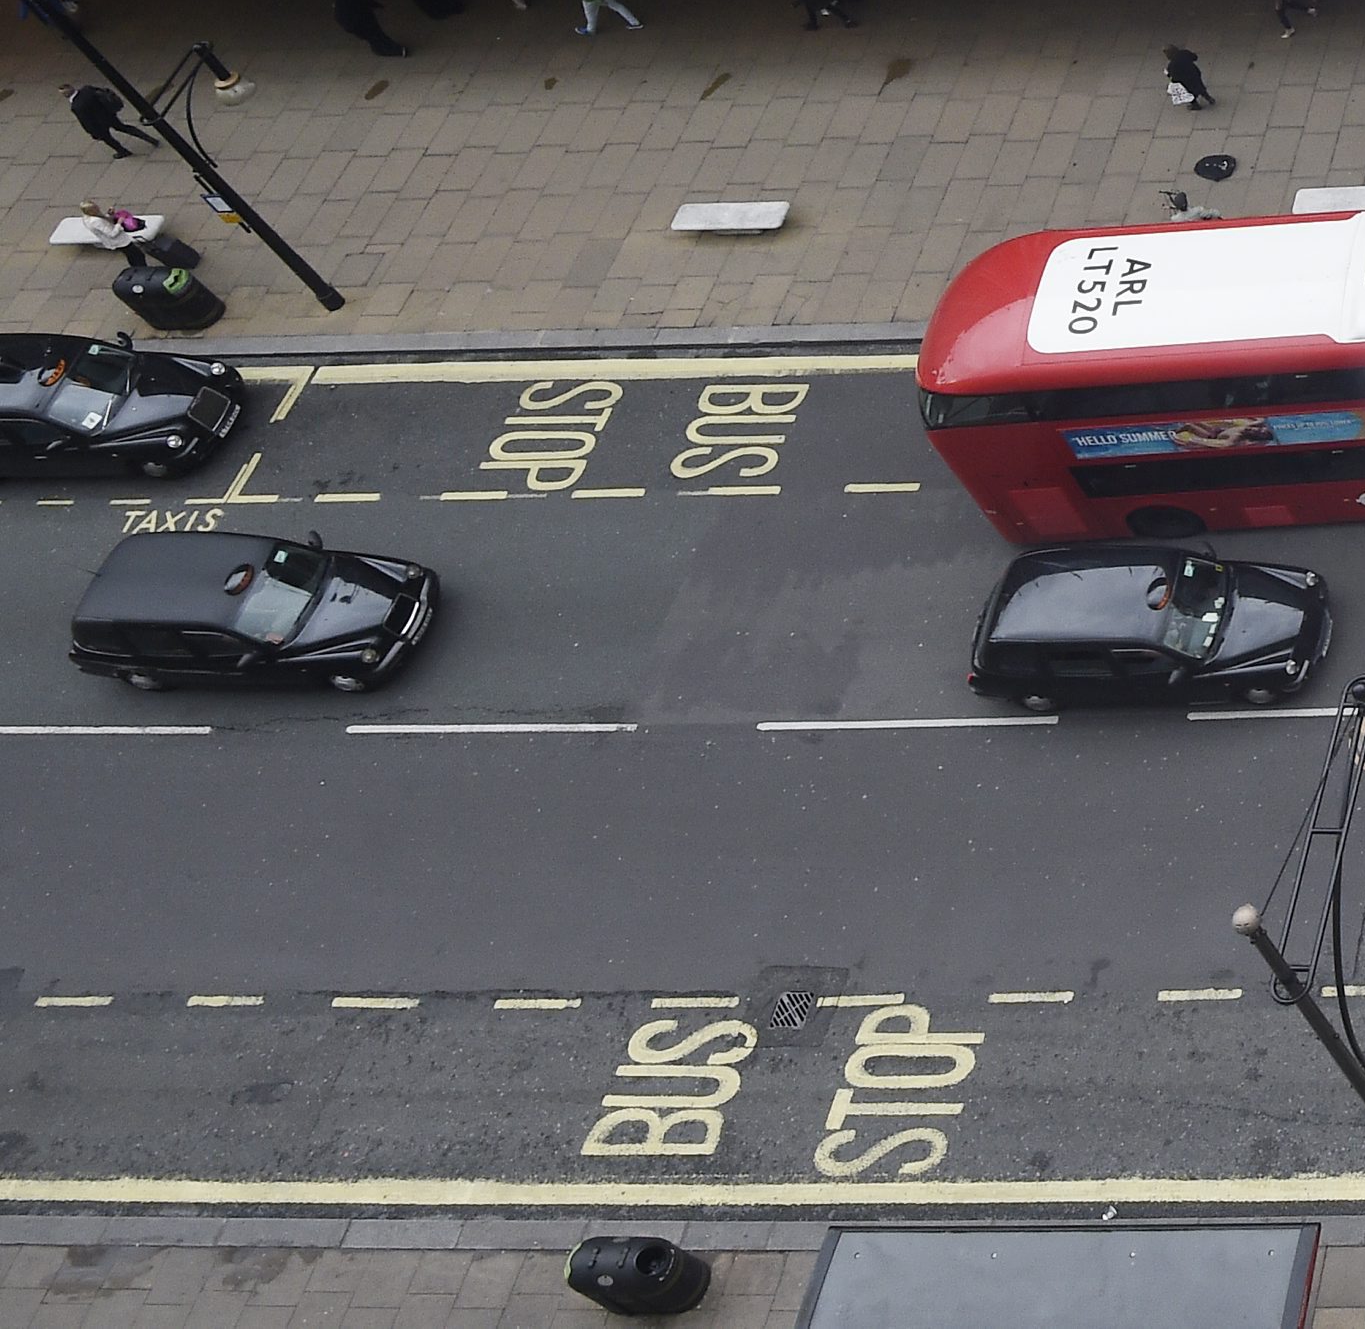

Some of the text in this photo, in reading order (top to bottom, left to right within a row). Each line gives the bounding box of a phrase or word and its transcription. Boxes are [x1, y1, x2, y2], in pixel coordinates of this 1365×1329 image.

[1068, 246, 1119, 334] LT520
[1112, 258, 1152, 316] ARL
[479, 380, 624, 492] STOP
[669, 382, 810, 479] BUS
[1119, 430, 1177, 443] SUMMER
[119, 508, 226, 534] TAXIS
[581, 1019, 758, 1157] BUS
[812, 1003, 987, 1178] STOP
